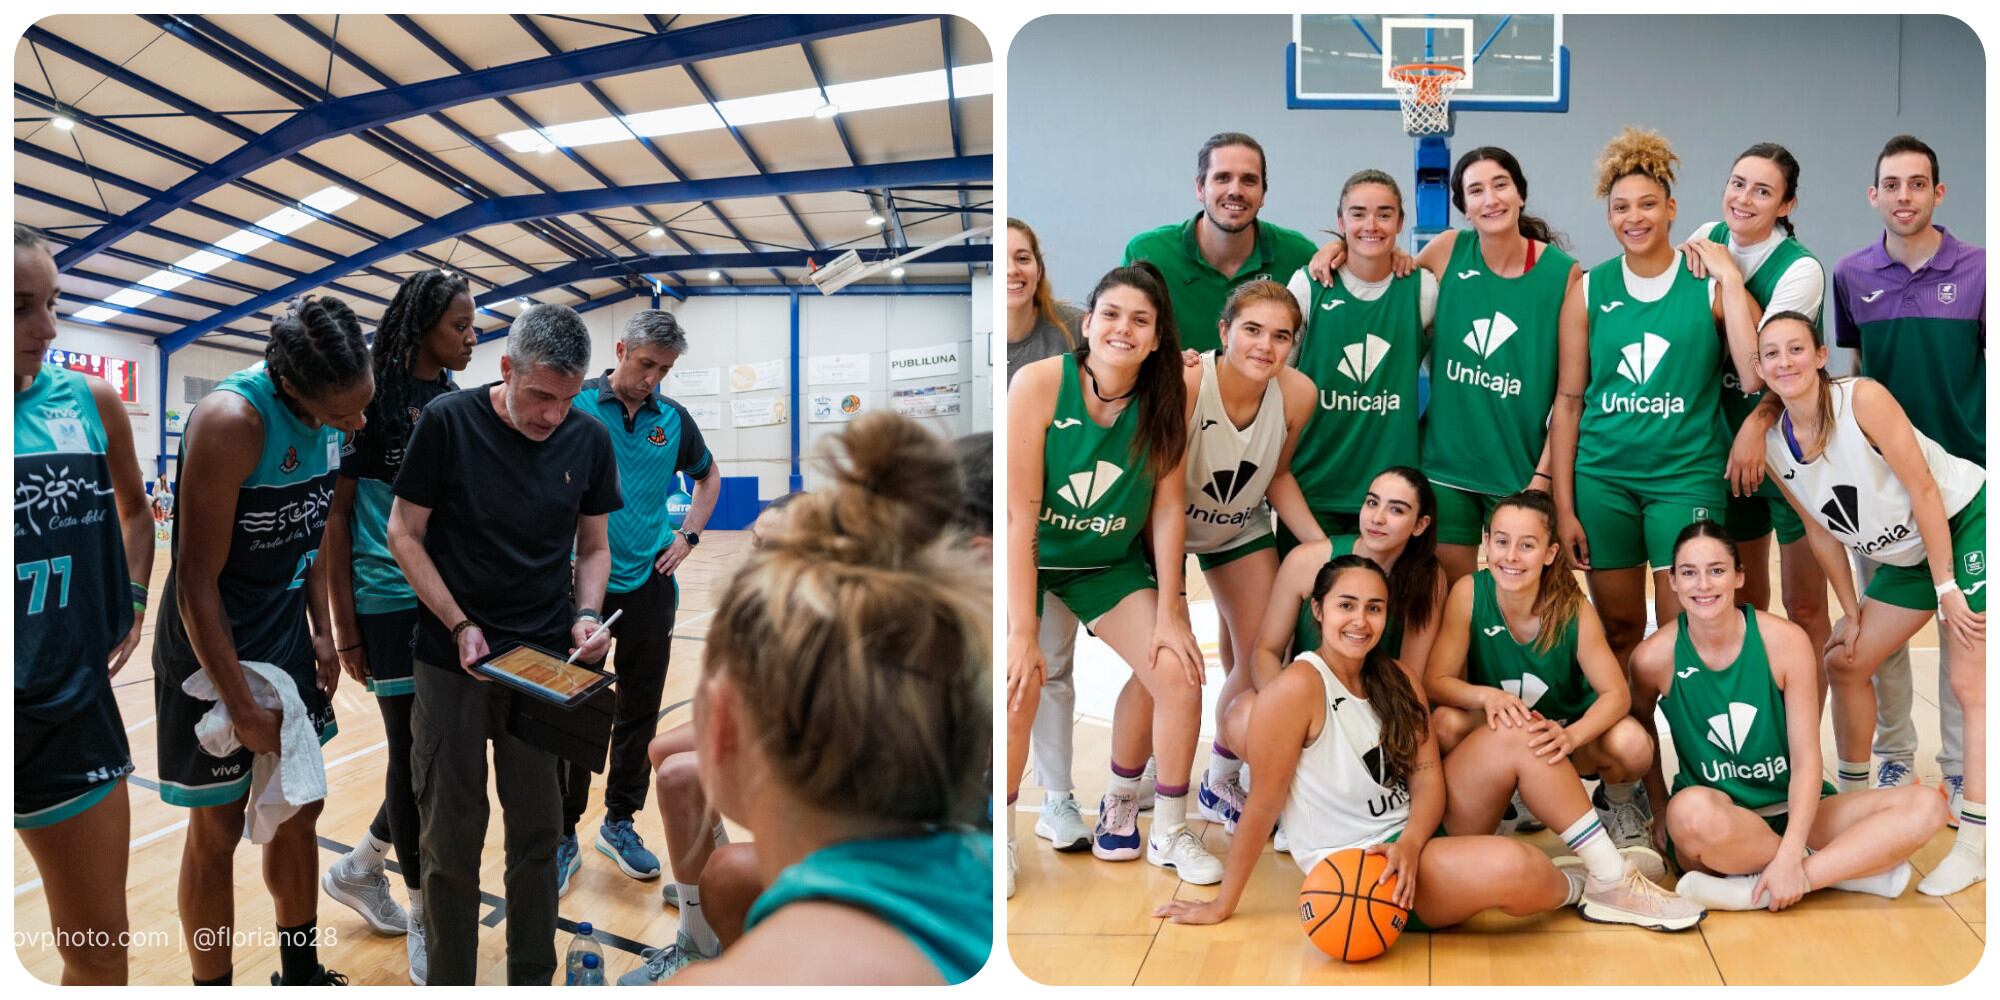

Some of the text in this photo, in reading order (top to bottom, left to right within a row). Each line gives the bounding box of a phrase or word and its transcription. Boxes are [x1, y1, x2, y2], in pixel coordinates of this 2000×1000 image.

[892, 354, 957, 369] PUBLILUNA
[1447, 360, 1521, 399] Unicaja
[1320, 390, 1400, 416] Unicaja
[1602, 392, 1685, 419] Unicaja
[16, 555, 72, 616] 77
[211, 764, 240, 777] vive
[1701, 756, 1788, 782] Unicaja
